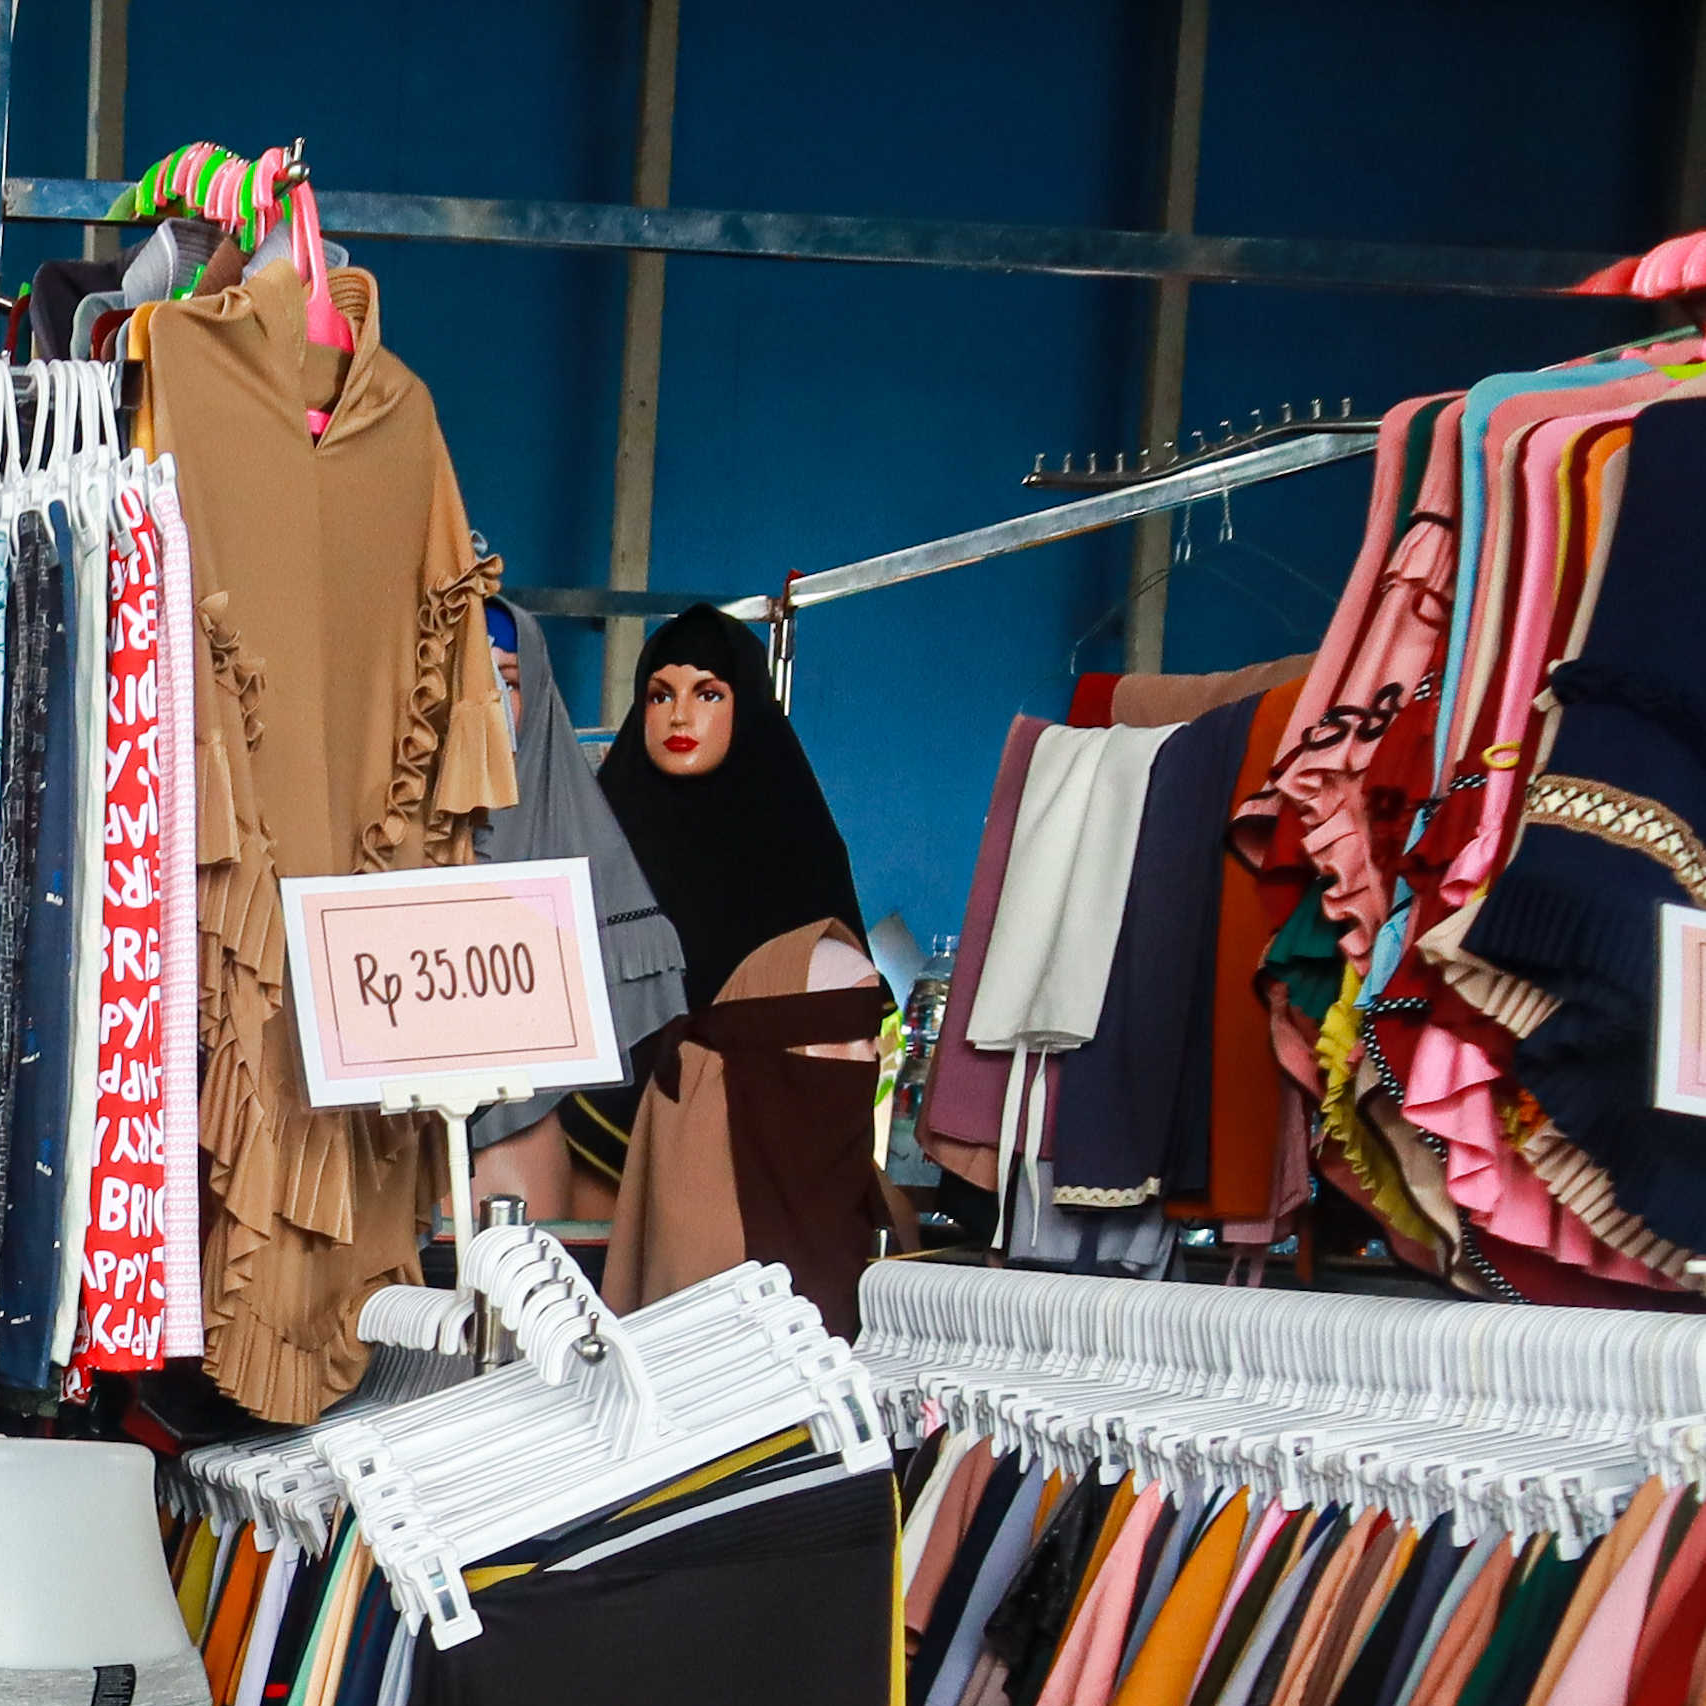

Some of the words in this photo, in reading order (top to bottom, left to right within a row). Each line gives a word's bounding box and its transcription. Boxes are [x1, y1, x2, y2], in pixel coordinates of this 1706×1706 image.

[354, 952, 402, 1027] Rp
[410, 942, 536, 1001] 35.000
[91, 1303, 164, 1361] APPY
